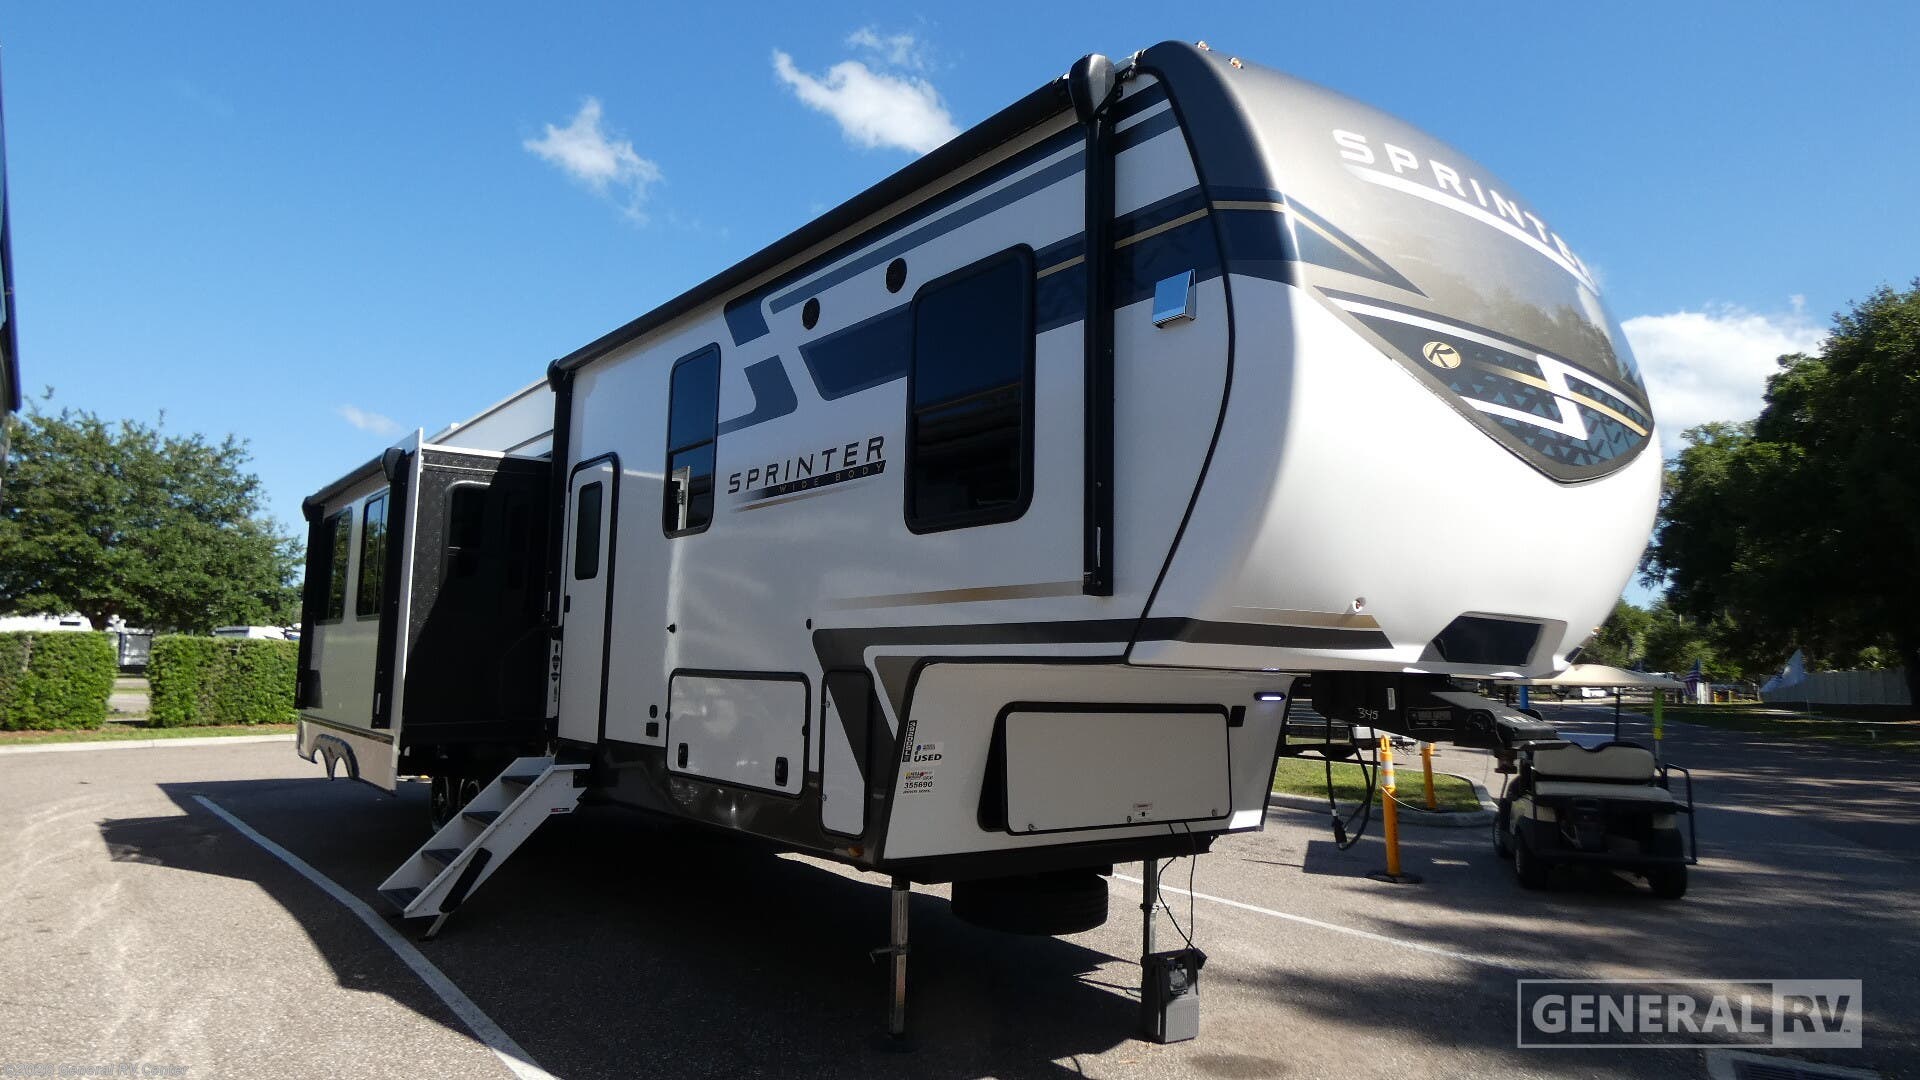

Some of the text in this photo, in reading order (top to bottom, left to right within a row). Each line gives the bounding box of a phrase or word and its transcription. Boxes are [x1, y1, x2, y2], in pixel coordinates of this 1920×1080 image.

[727, 435, 885, 494] SPRINTER
[779, 463, 883, 493] WIDE BODY
[913, 753, 942, 762] USED
